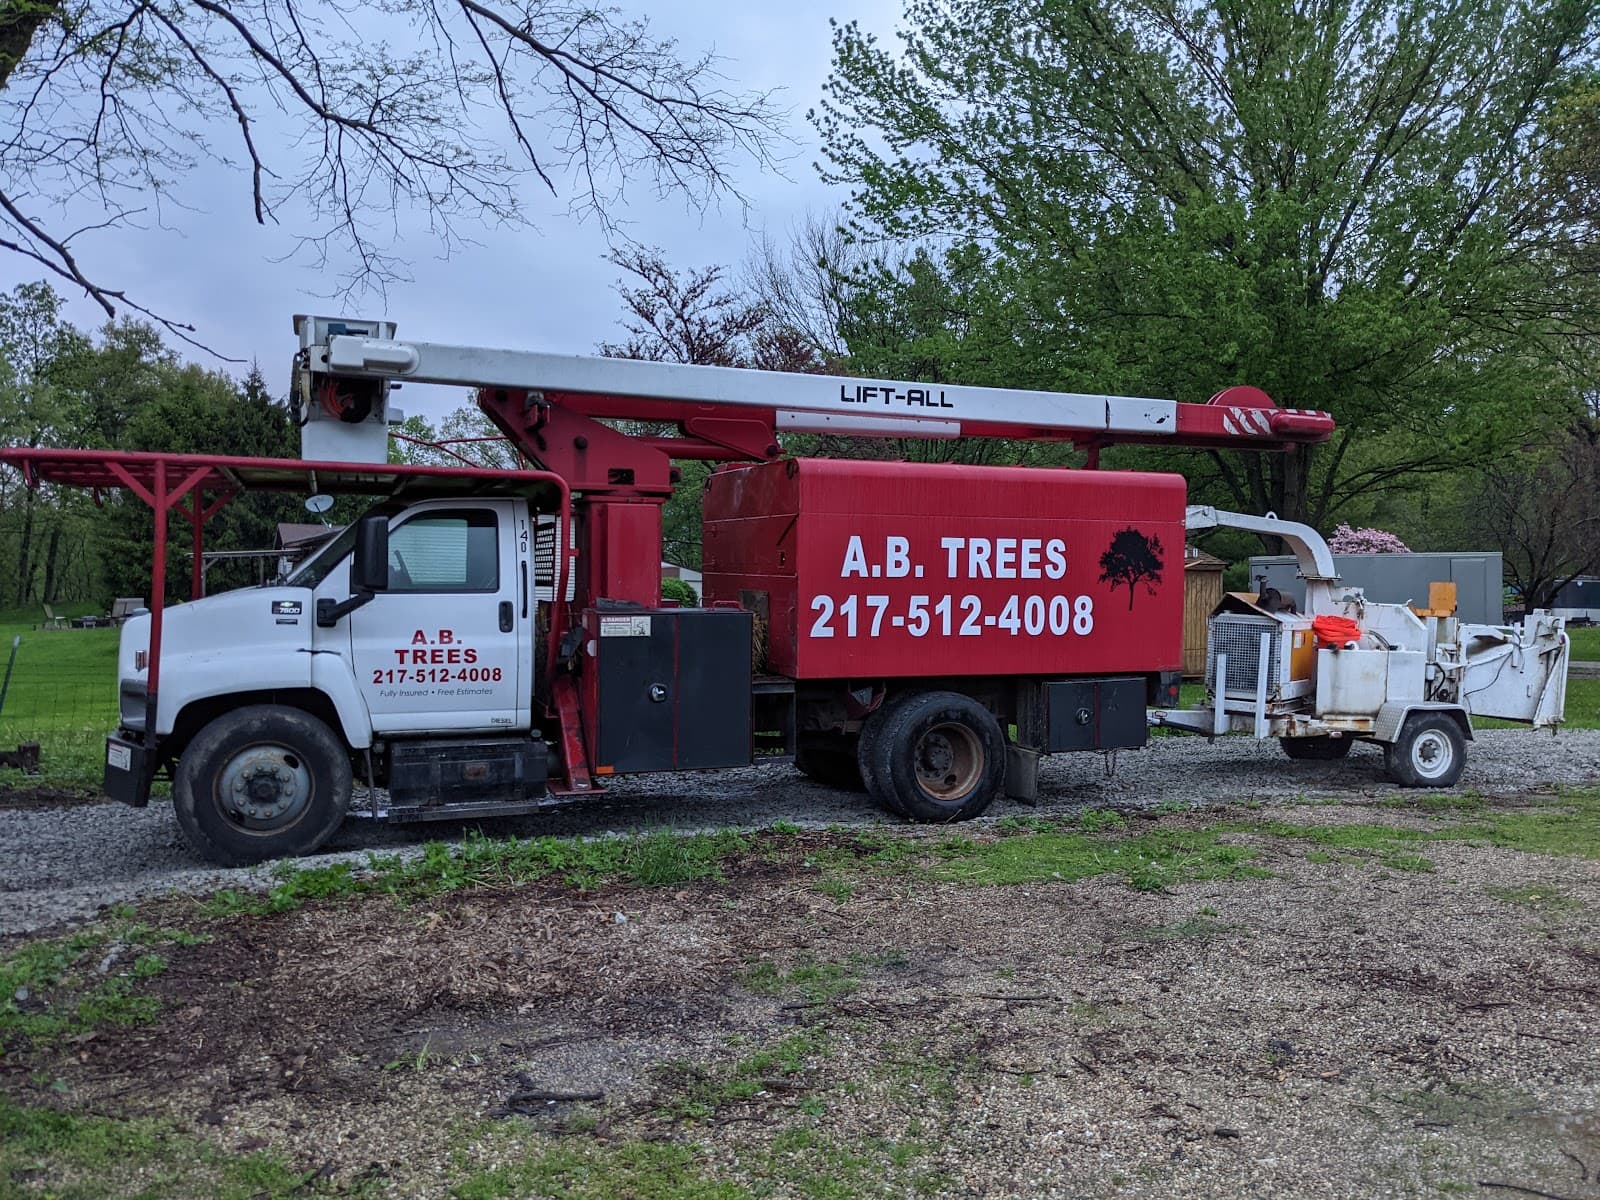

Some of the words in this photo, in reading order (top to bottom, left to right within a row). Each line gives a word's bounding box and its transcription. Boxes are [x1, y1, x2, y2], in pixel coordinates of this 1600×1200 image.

[840, 384, 954, 408] LIFT-ALL
[519, 519, 529, 553] 140
[840, 535, 924, 579] A.B.
[941, 537, 1068, 580] TREES
[809, 594, 1095, 638] 217-512-4008
[411, 629, 463, 645] A.B.
[394, 648, 478, 665] TREES
[372, 667, 503, 684] 217-512-4008
[379, 689, 398, 698] Fully
[399, 689, 429, 697] Insured
[437, 688, 454, 696] Free
[456, 687, 493, 696] Estimates
